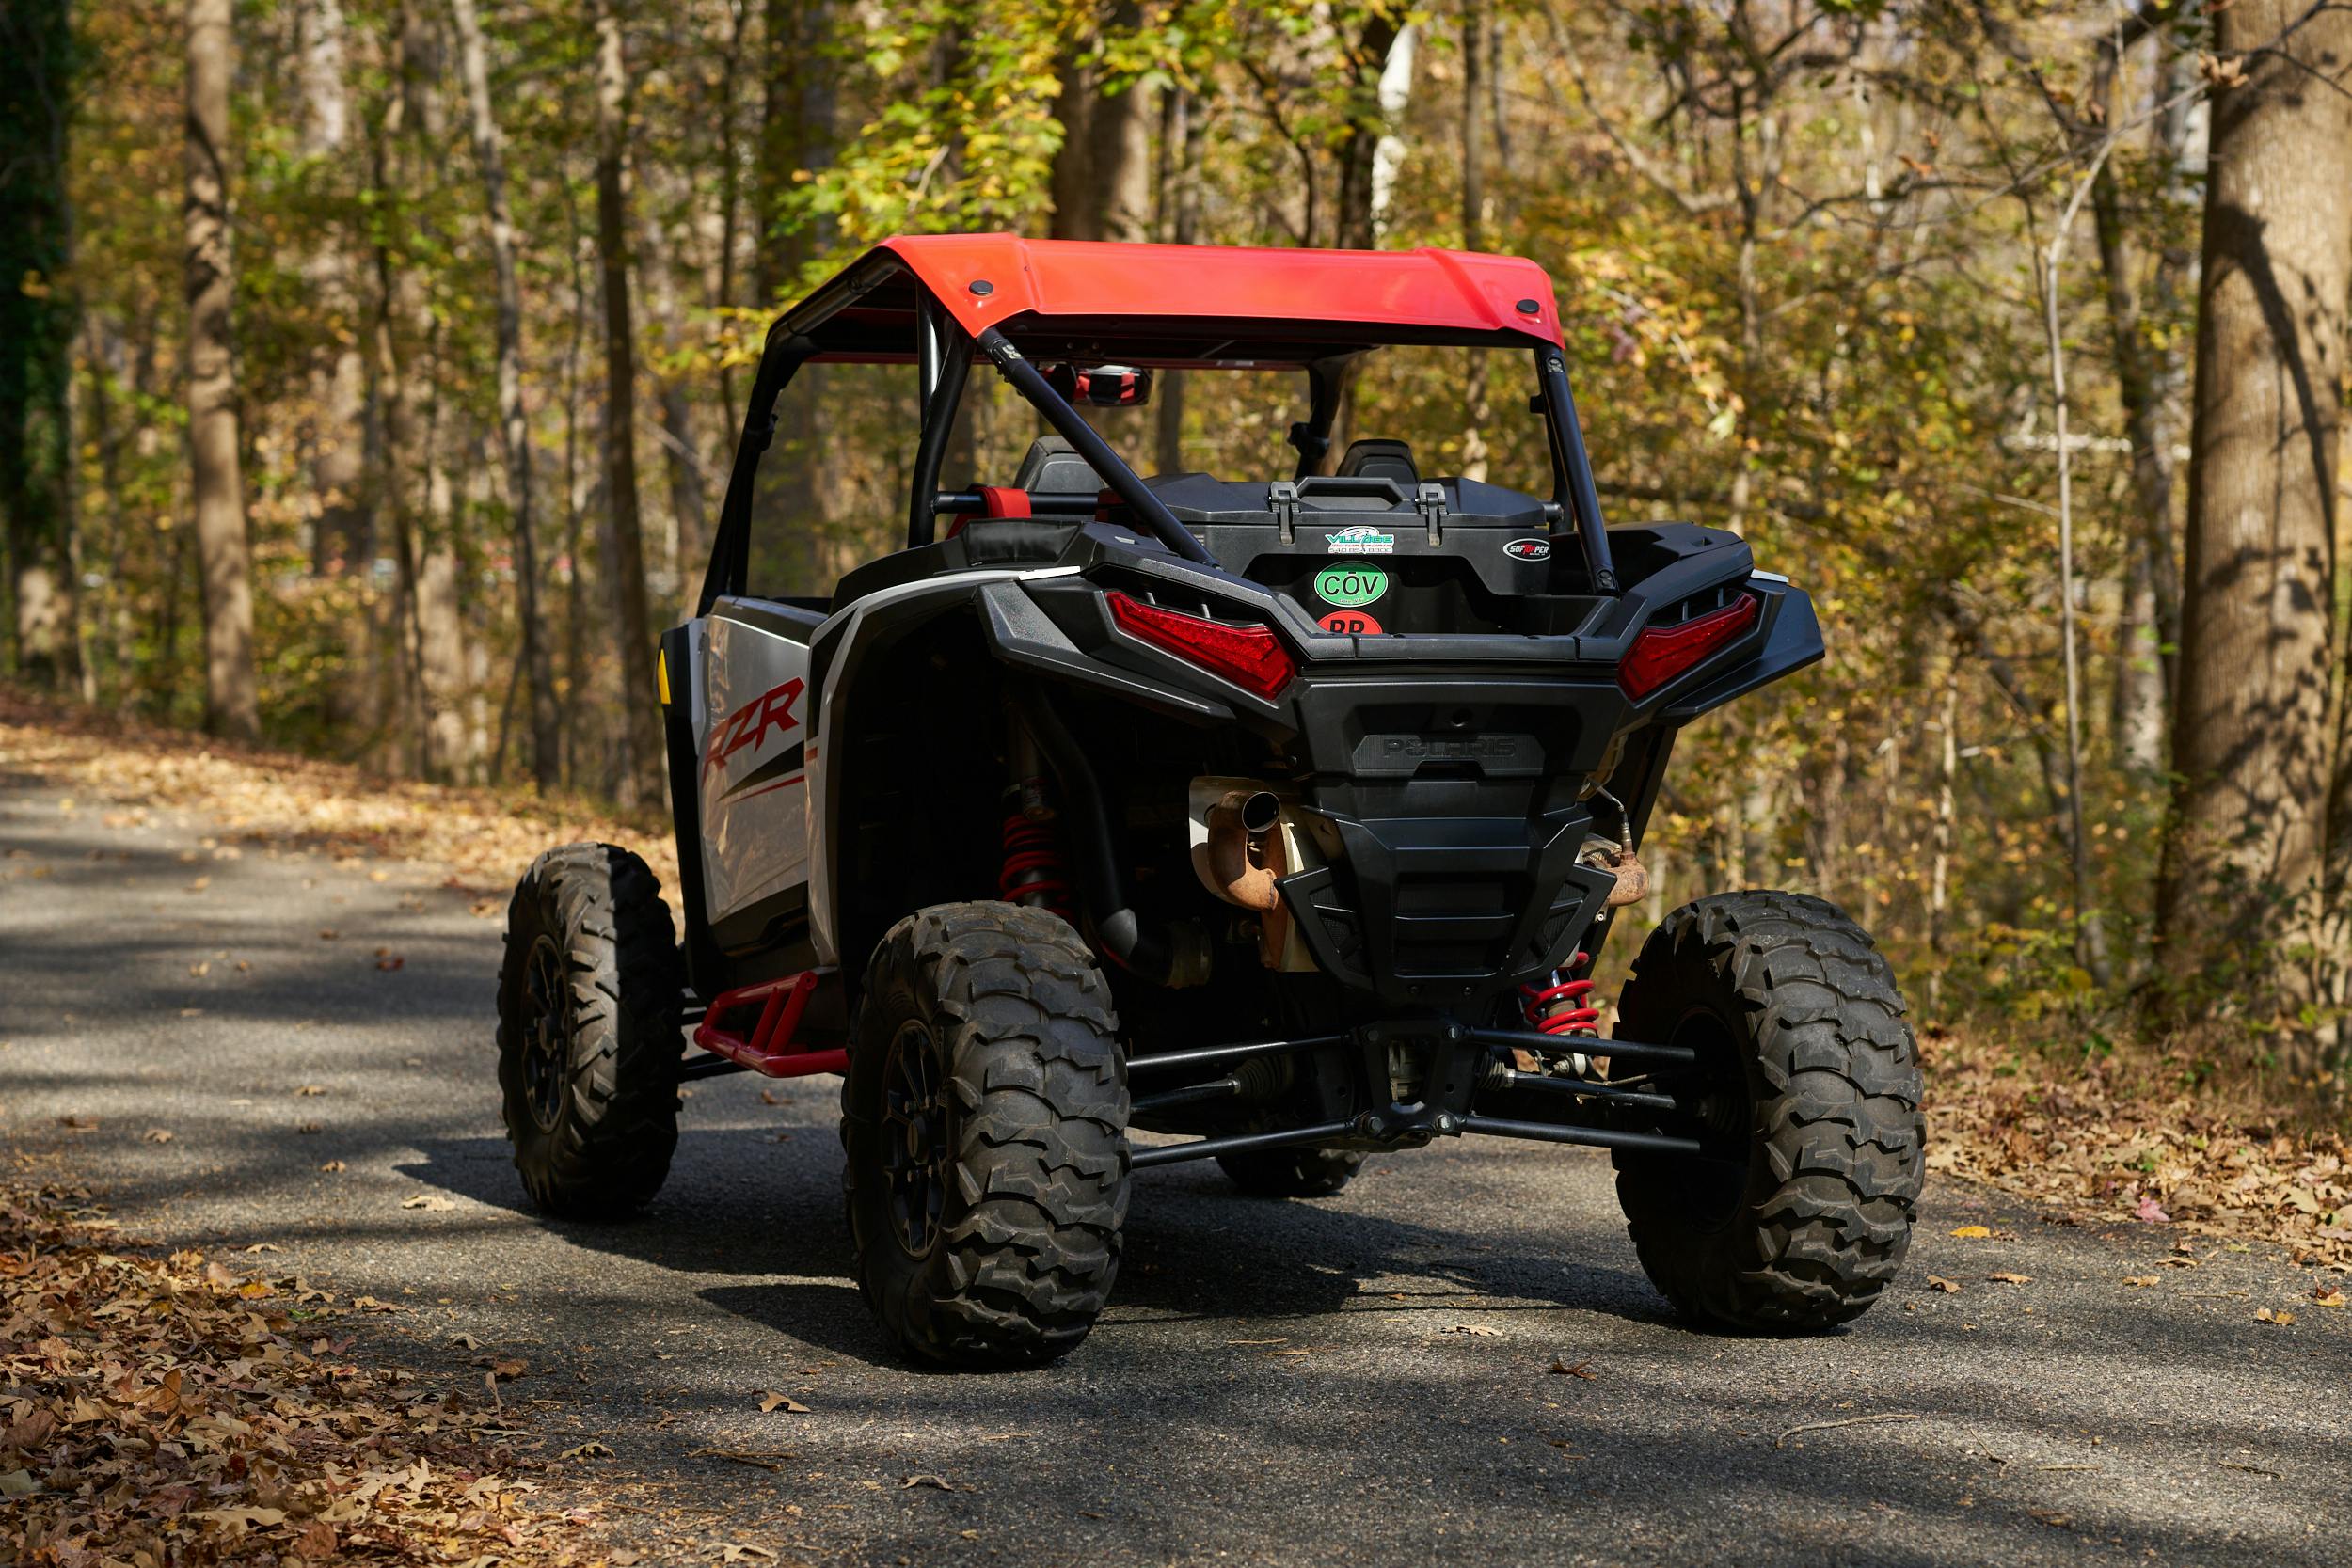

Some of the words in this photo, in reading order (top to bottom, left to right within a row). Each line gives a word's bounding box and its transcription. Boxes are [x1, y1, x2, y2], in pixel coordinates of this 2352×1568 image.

[1327, 535, 1393, 544] VILLAGE
[702, 677, 805, 788] RZR
[1383, 738, 1516, 758] POLARIS
